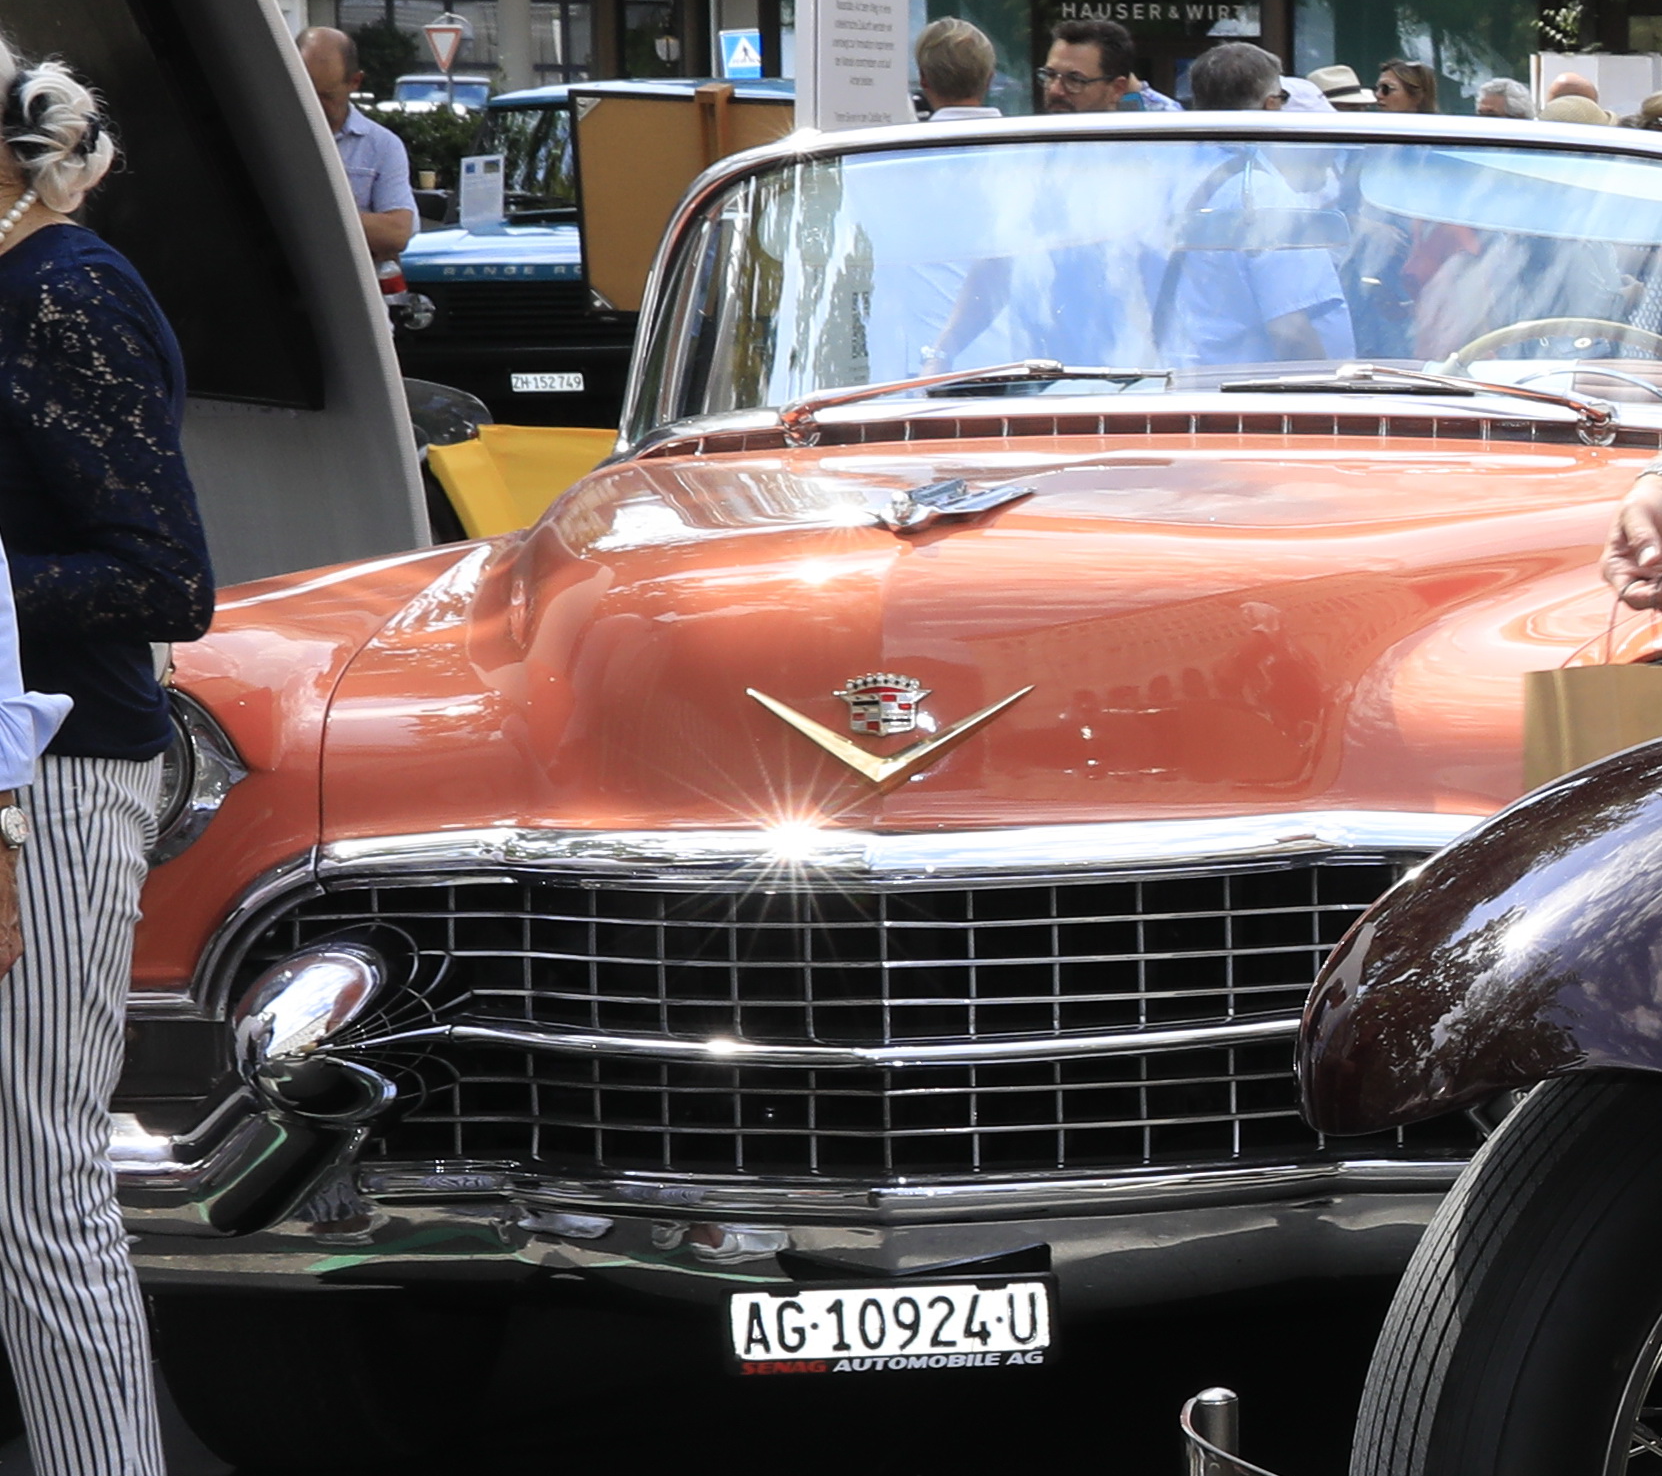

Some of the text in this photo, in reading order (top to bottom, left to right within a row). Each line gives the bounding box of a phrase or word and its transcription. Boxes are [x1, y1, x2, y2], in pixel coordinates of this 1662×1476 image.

[1061, 2, 1162, 20] HAUSER
[1168, 6, 1180, 20] &
[443, 266, 535, 275] RANGE
[740, 1350, 1045, 1375] SENAG AUTOMOBILE AG
